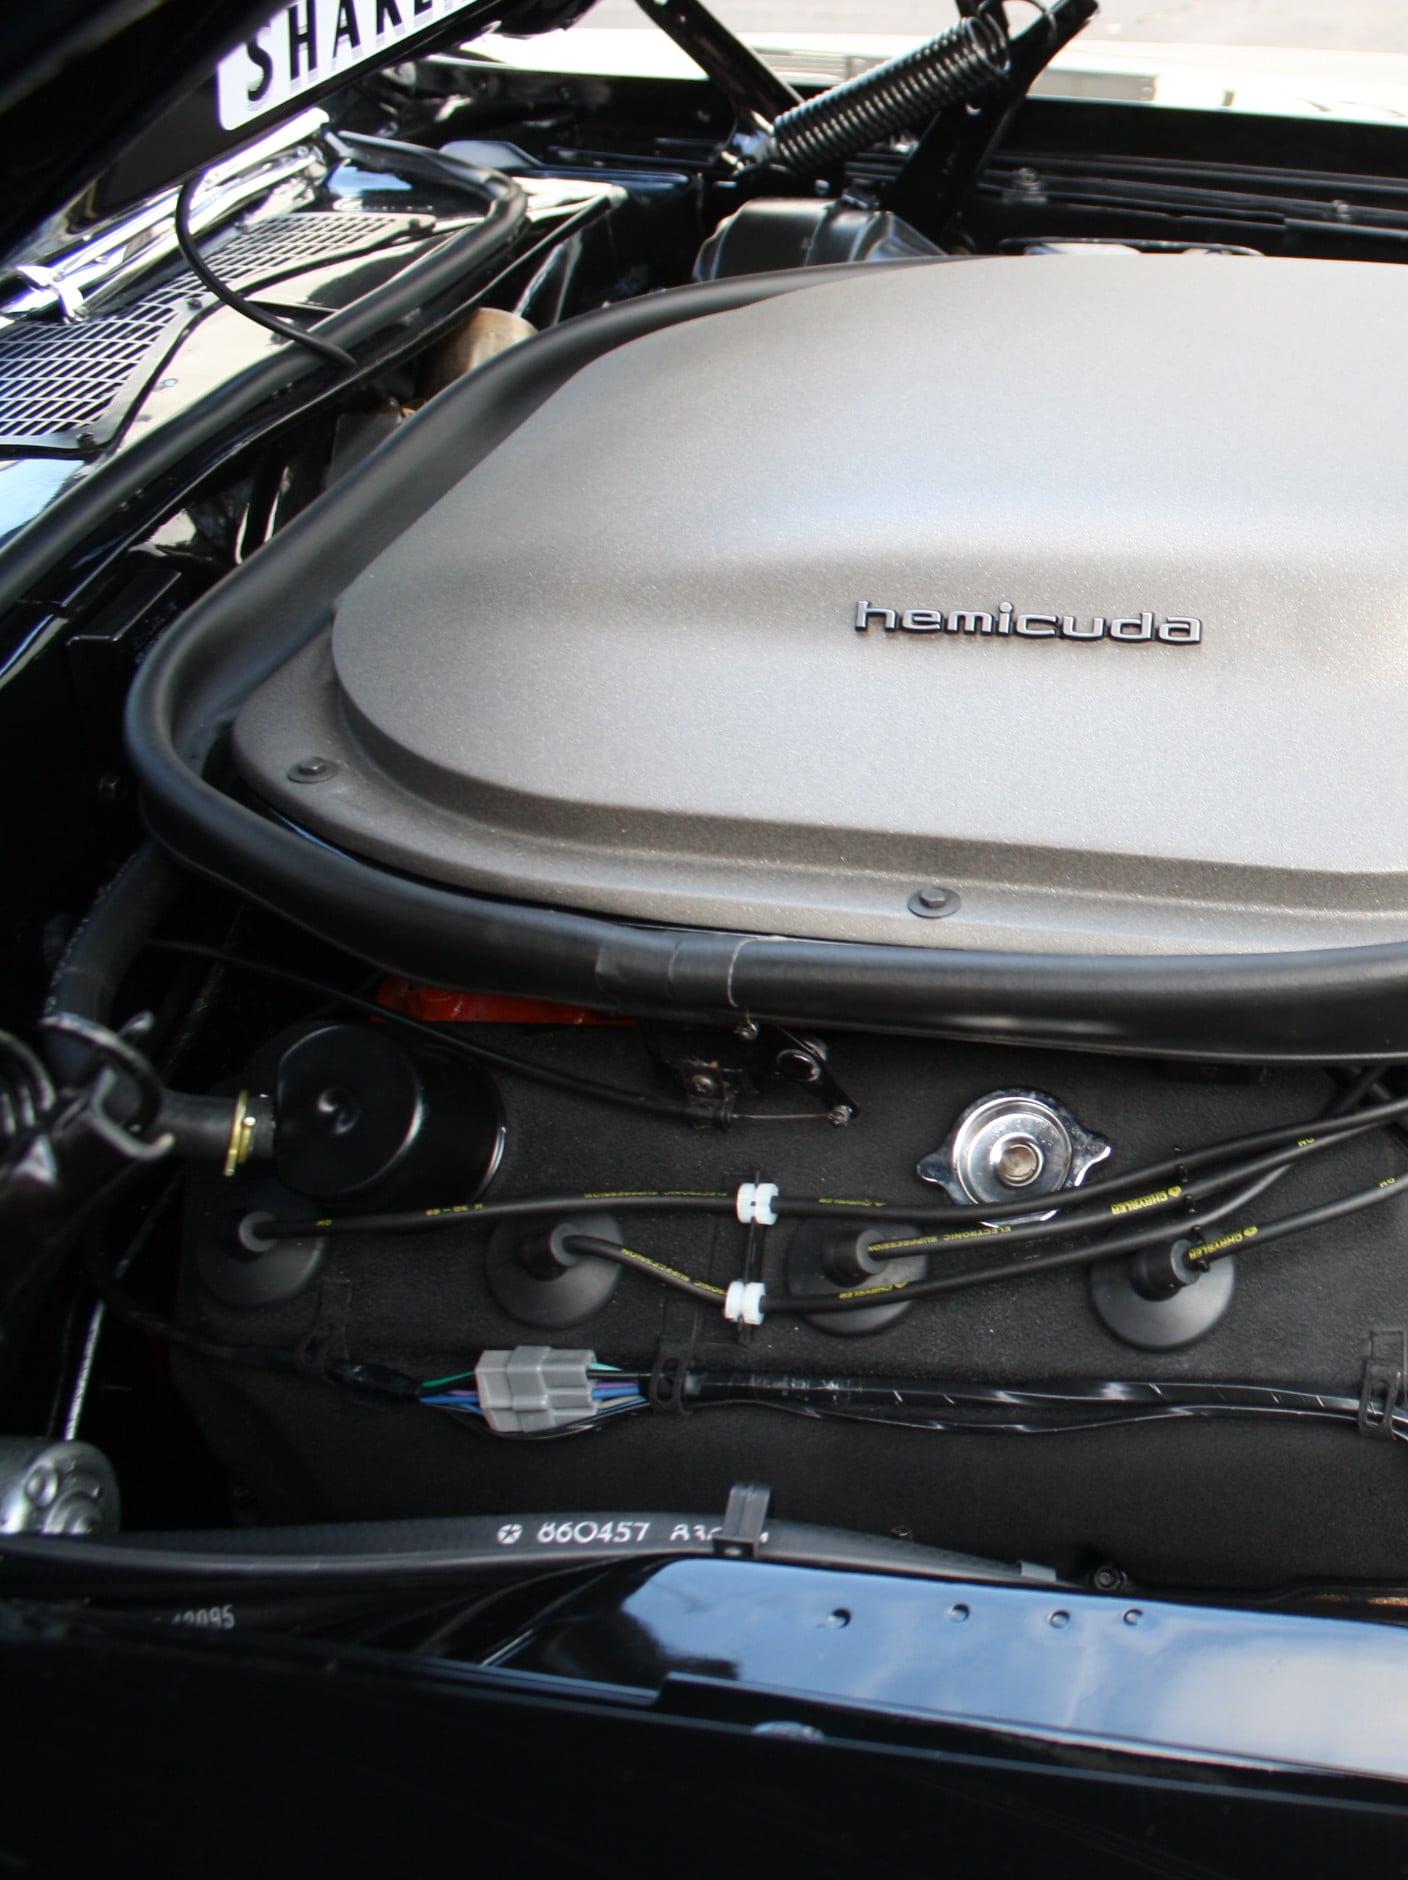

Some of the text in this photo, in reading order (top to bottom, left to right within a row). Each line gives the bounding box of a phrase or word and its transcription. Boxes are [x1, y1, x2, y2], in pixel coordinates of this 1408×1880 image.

[854, 600, 1202, 643] hemicuda
[1110, 1189, 1169, 1216] CHRYSLER
[943, 1225, 1012, 1242] ELECTRONIC
[1188, 1231, 1244, 1260] CHRYSLER
[536, 1520, 650, 1544] 860457
